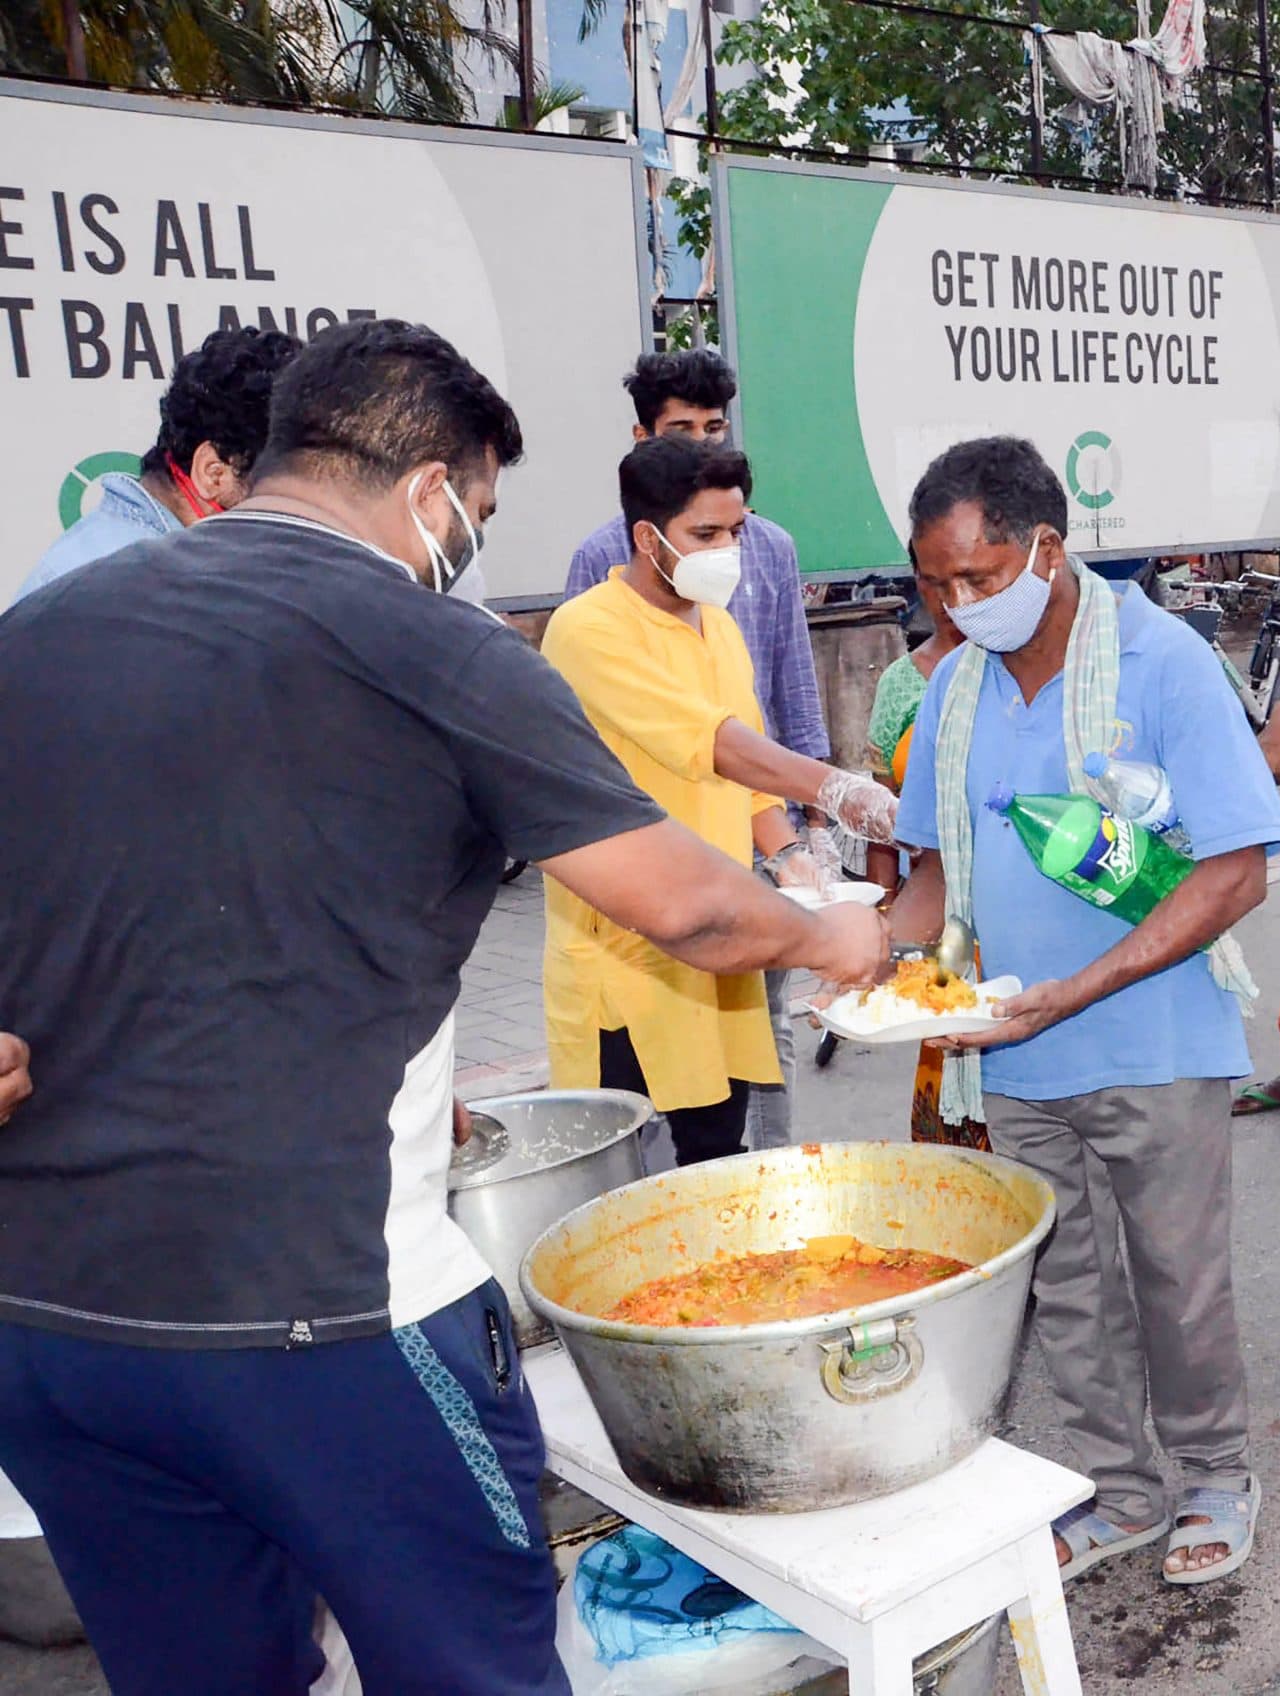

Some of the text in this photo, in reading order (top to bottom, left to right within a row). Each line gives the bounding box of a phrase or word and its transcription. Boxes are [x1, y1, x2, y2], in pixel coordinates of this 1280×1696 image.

[51, 190, 126, 275] IS
[154, 199, 276, 281] ALL
[931, 249, 1223, 319] GET MORE OUT OF
[944, 325, 1042, 382] YOUR
